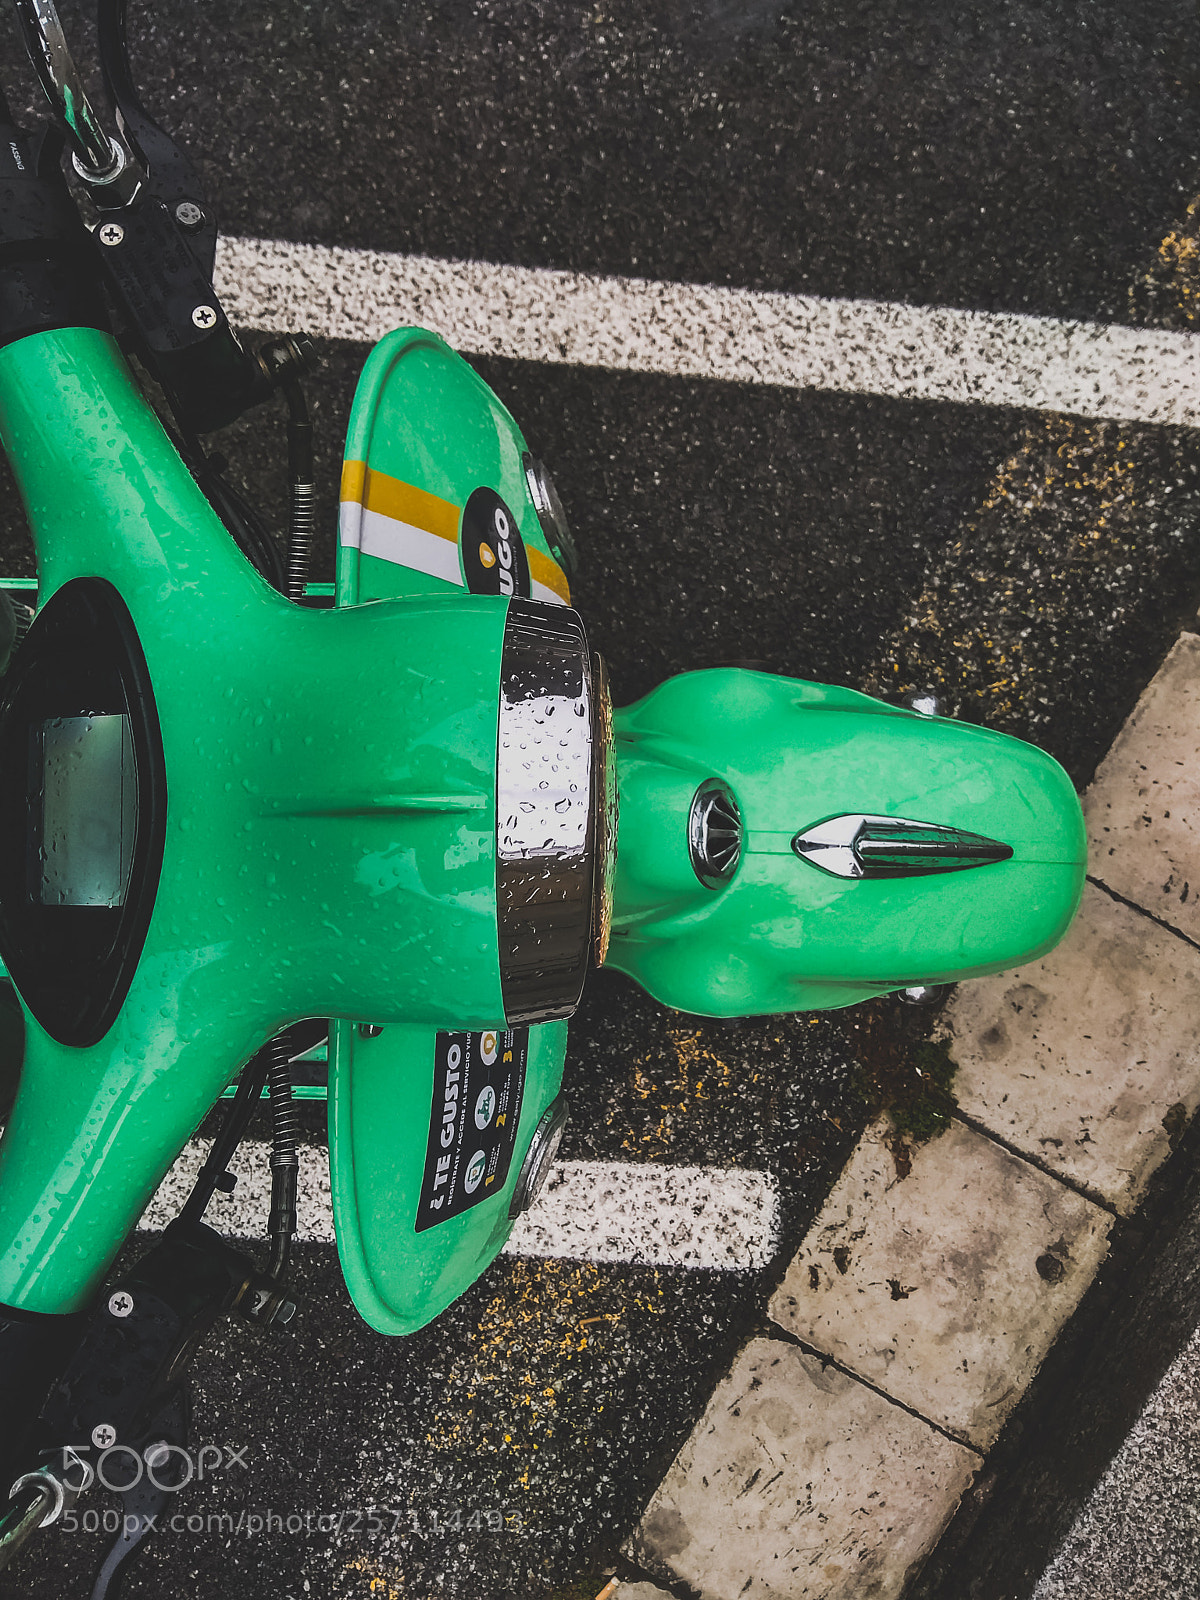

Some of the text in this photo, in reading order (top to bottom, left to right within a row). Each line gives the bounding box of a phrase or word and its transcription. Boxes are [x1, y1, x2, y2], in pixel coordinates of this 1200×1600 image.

[9, 142, 25, 170] PASSING
[494, 507, 514, 596] UGO
[503, 1050, 513, 1063] 3
[440, 1043, 462, 1148] GUSTO
[457, 1108, 466, 1145] ACCEDE
[462, 1052, 471, 1094] SERVICIO
[495, 1113, 507, 1128] 2
[485, 1174, 495, 1187] 1
